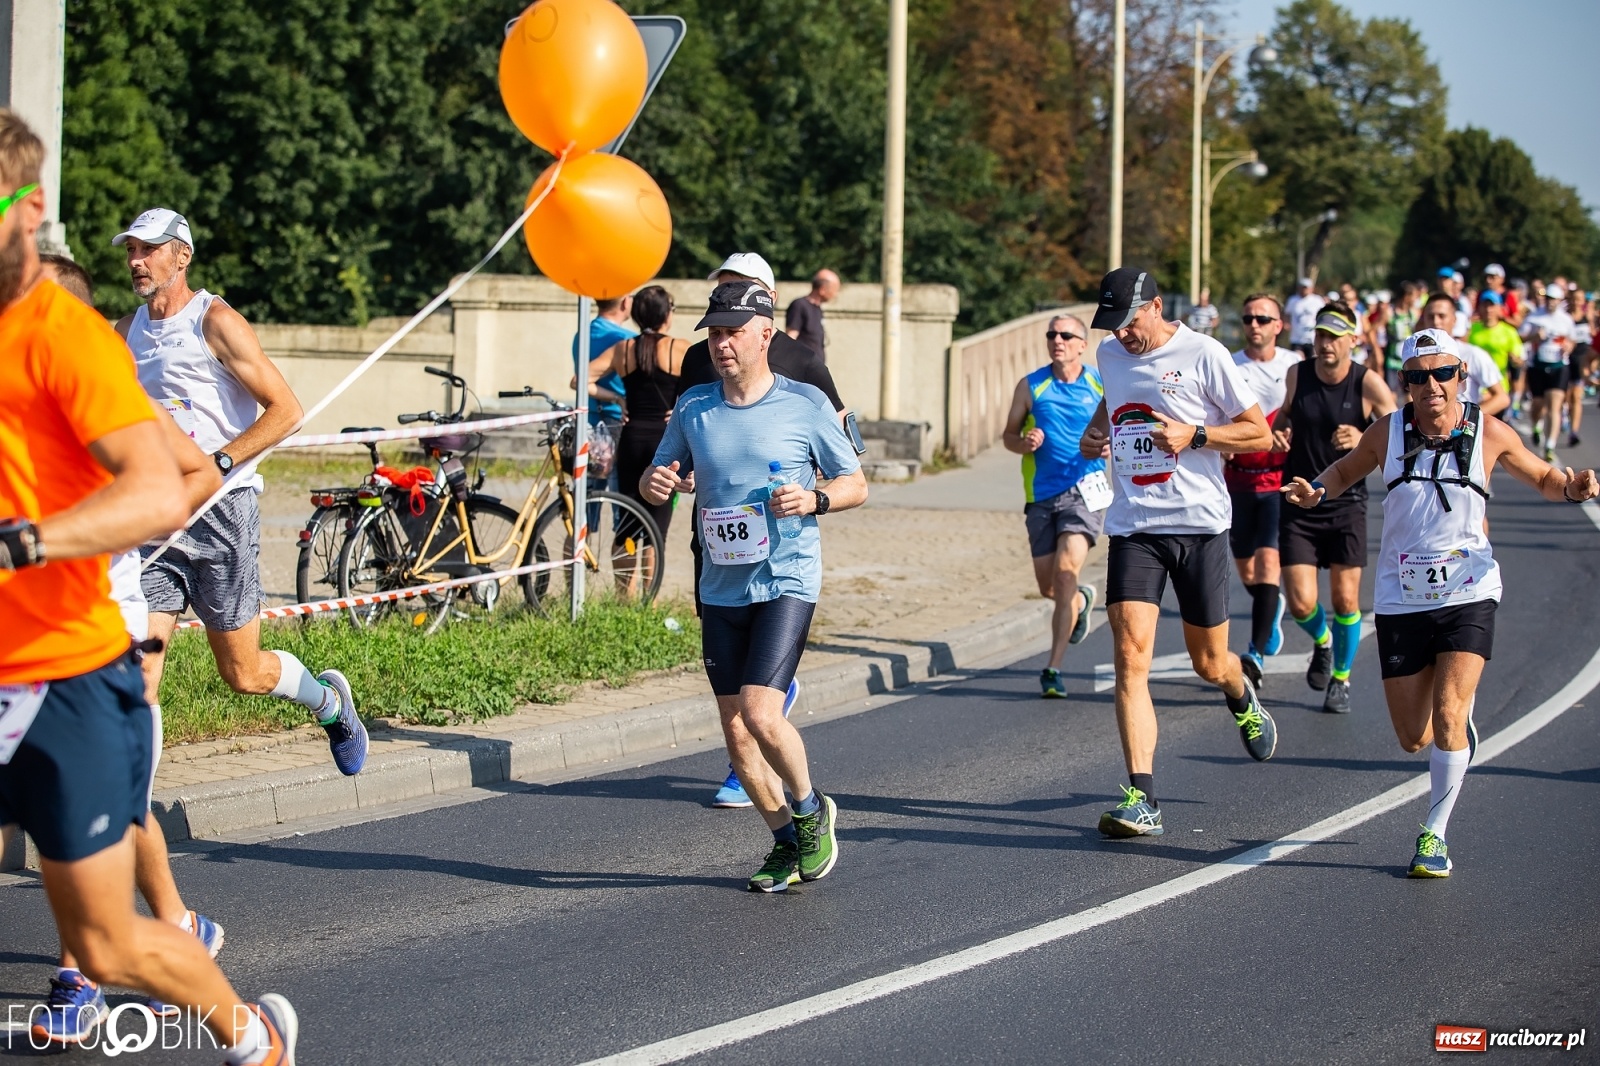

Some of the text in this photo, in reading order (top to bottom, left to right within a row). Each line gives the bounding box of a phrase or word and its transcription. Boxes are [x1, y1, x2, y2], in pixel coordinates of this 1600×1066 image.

[1133, 436, 1153, 454] 40
[717, 522, 749, 542] 458
[1426, 566, 1448, 583] 21
